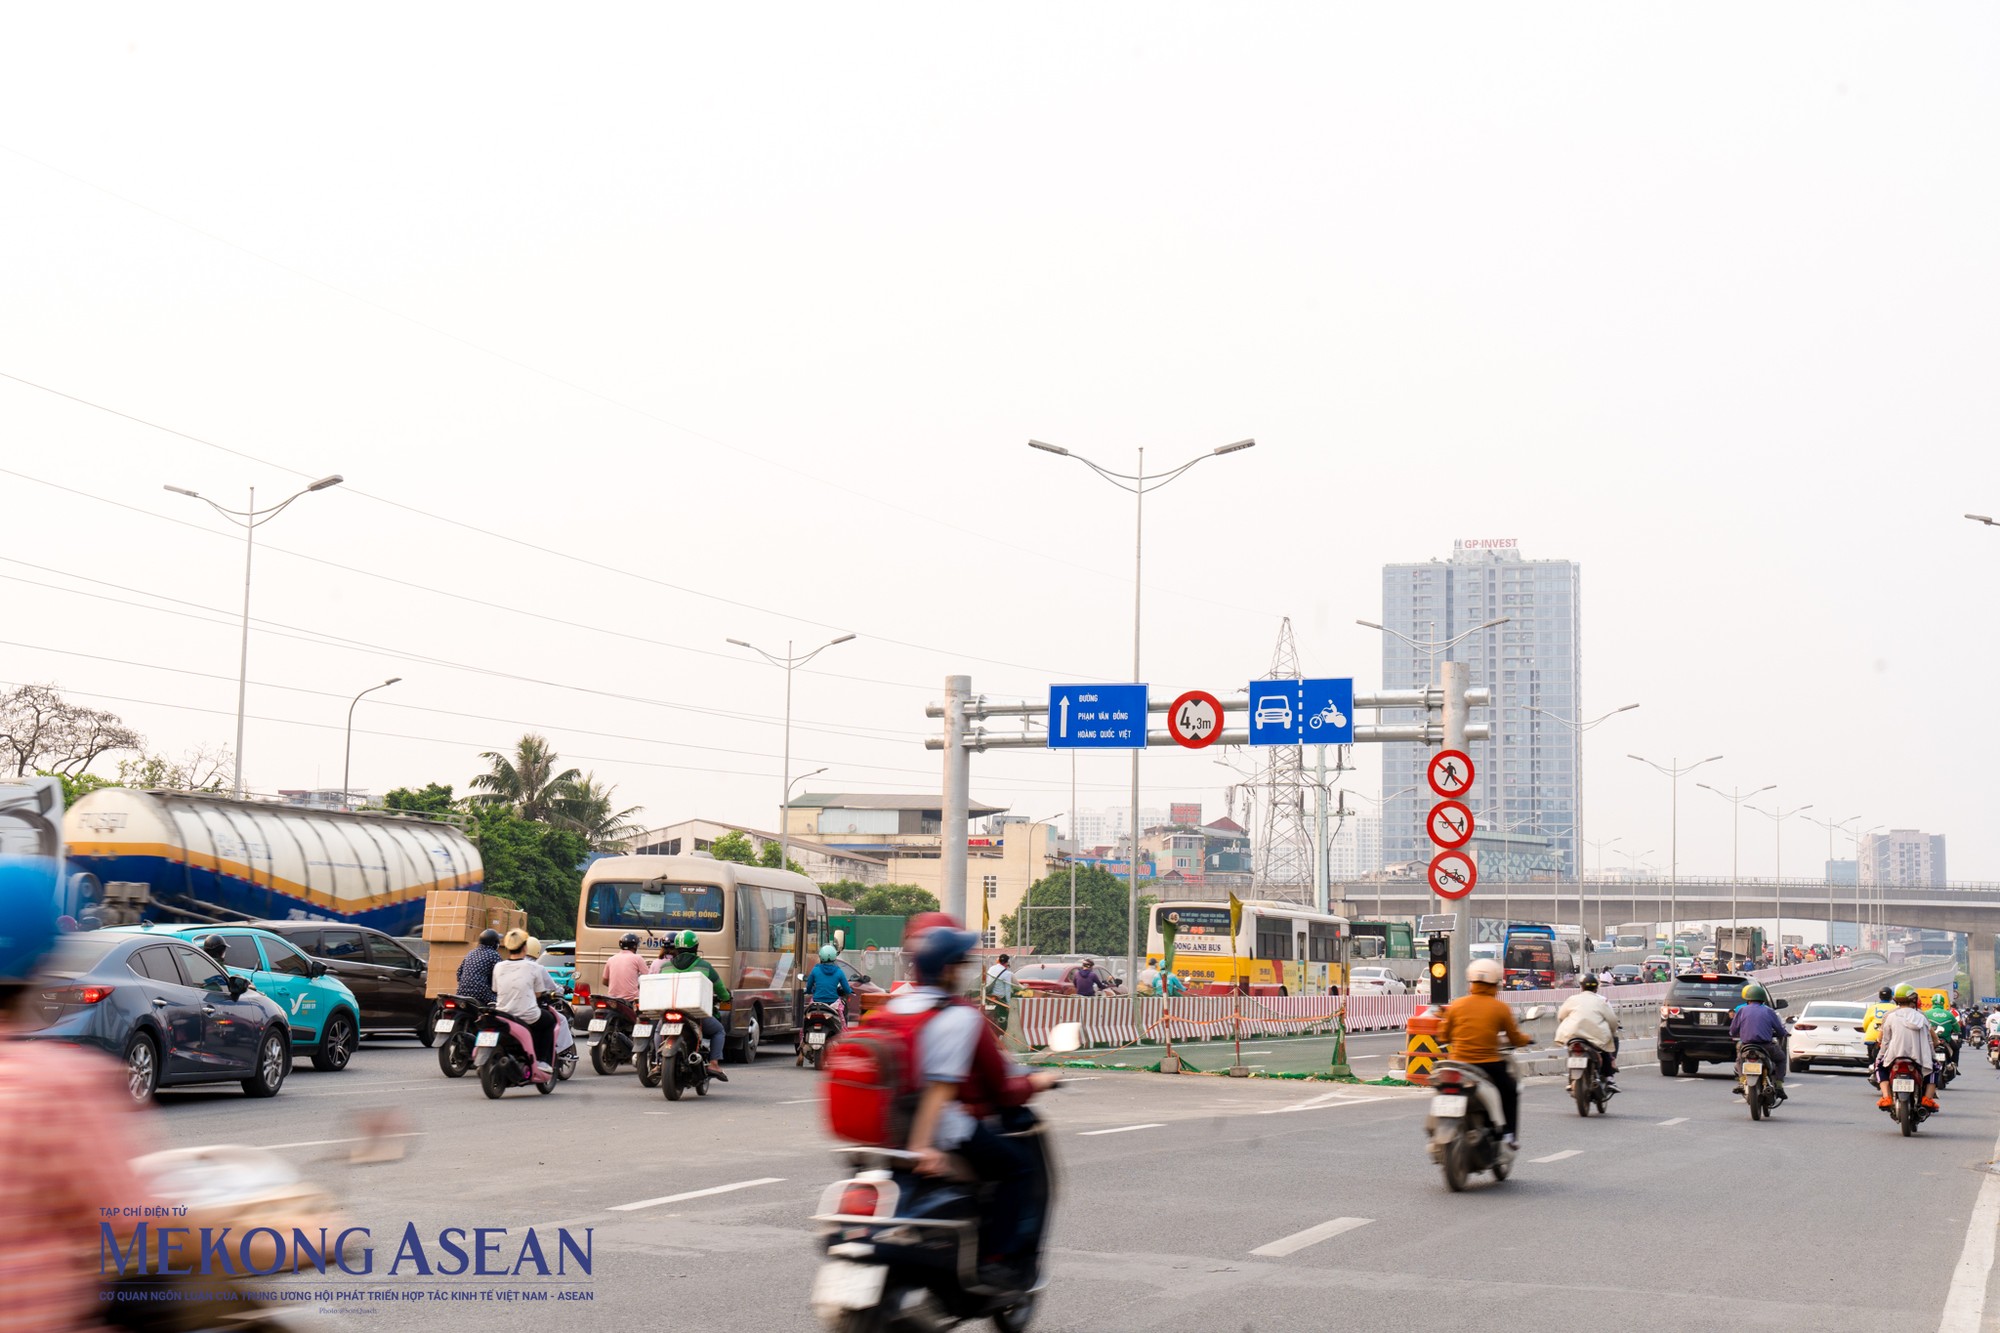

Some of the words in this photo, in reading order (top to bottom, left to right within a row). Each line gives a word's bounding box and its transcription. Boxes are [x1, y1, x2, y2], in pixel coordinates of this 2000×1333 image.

[1078, 712, 1095, 721] PHẠM
[1180, 707, 1211, 730] 4,3m
[1077, 729, 1097, 738] HOÀNG
[1100, 727, 1115, 739] QUỐC
[1118, 728, 1131, 740] VIỆT
[1192, 943, 1207, 951] ANH
